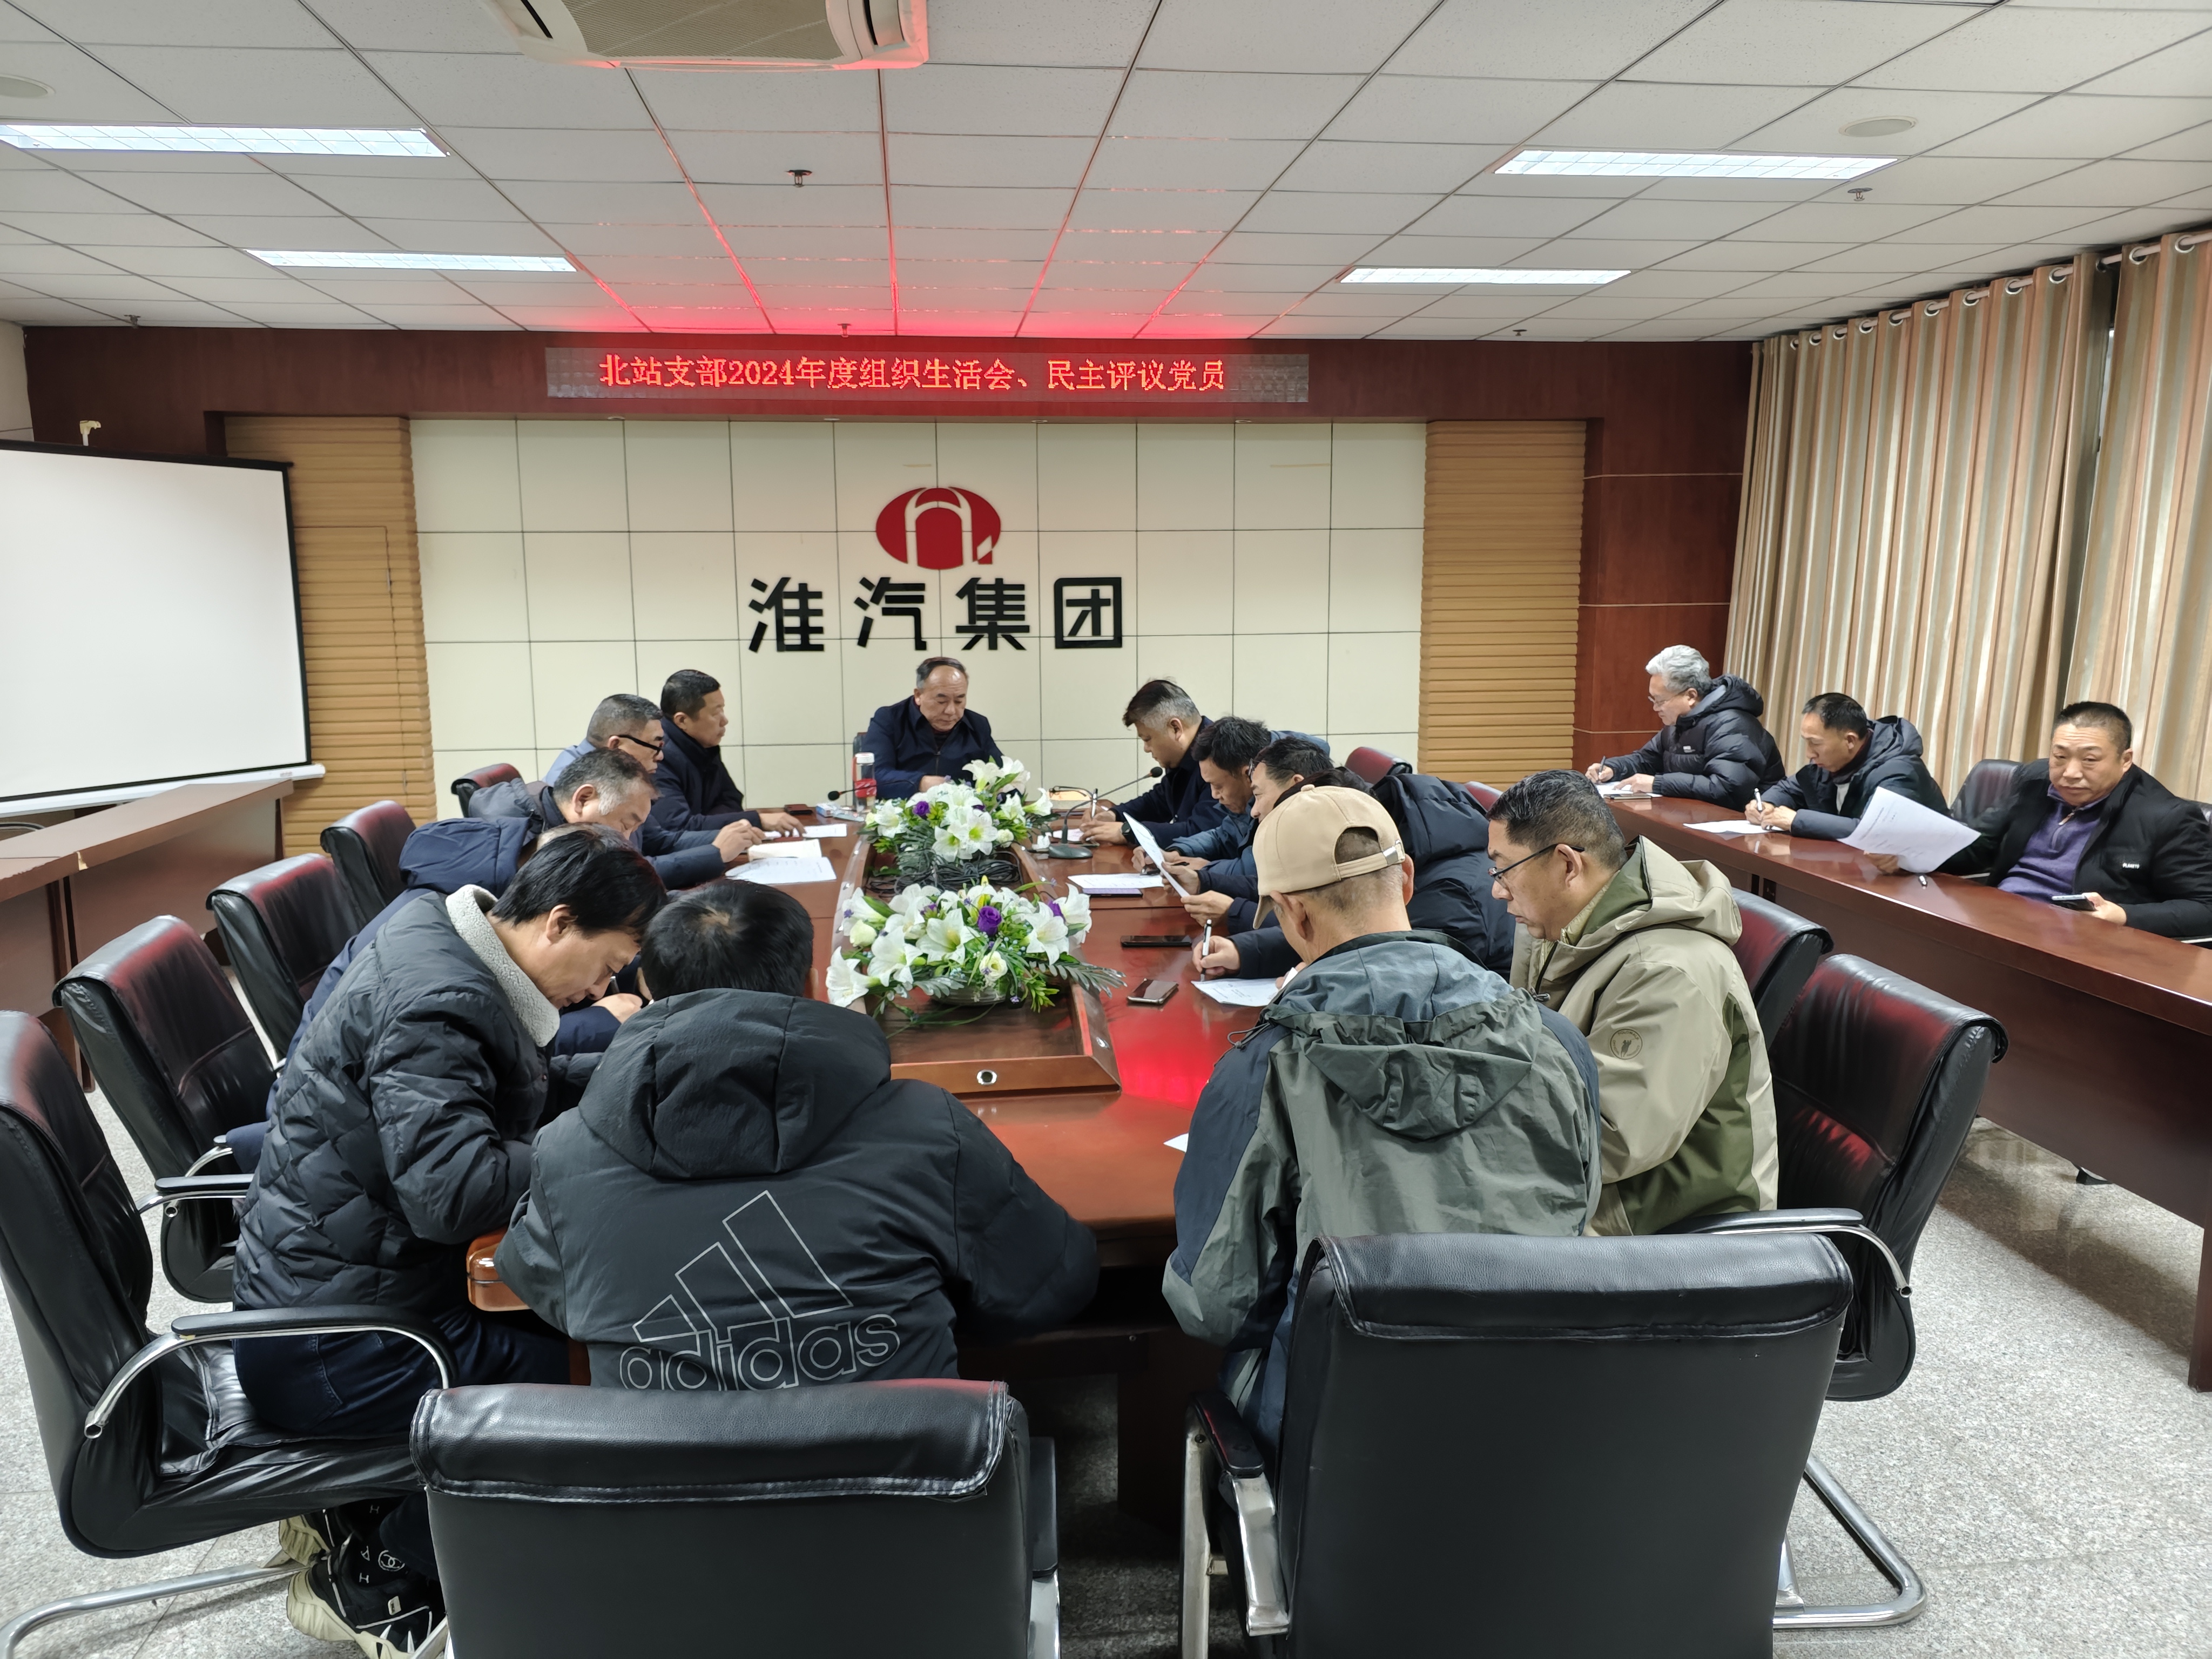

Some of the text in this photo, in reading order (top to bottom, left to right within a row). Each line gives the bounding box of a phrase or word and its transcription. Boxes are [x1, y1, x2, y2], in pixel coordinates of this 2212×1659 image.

[599, 354, 1225, 391] 北站支部2024年度组织生活会、民主评议党员
[748, 577, 1123, 653] 淮汽集团
[619, 1313, 900, 1391] adidas
